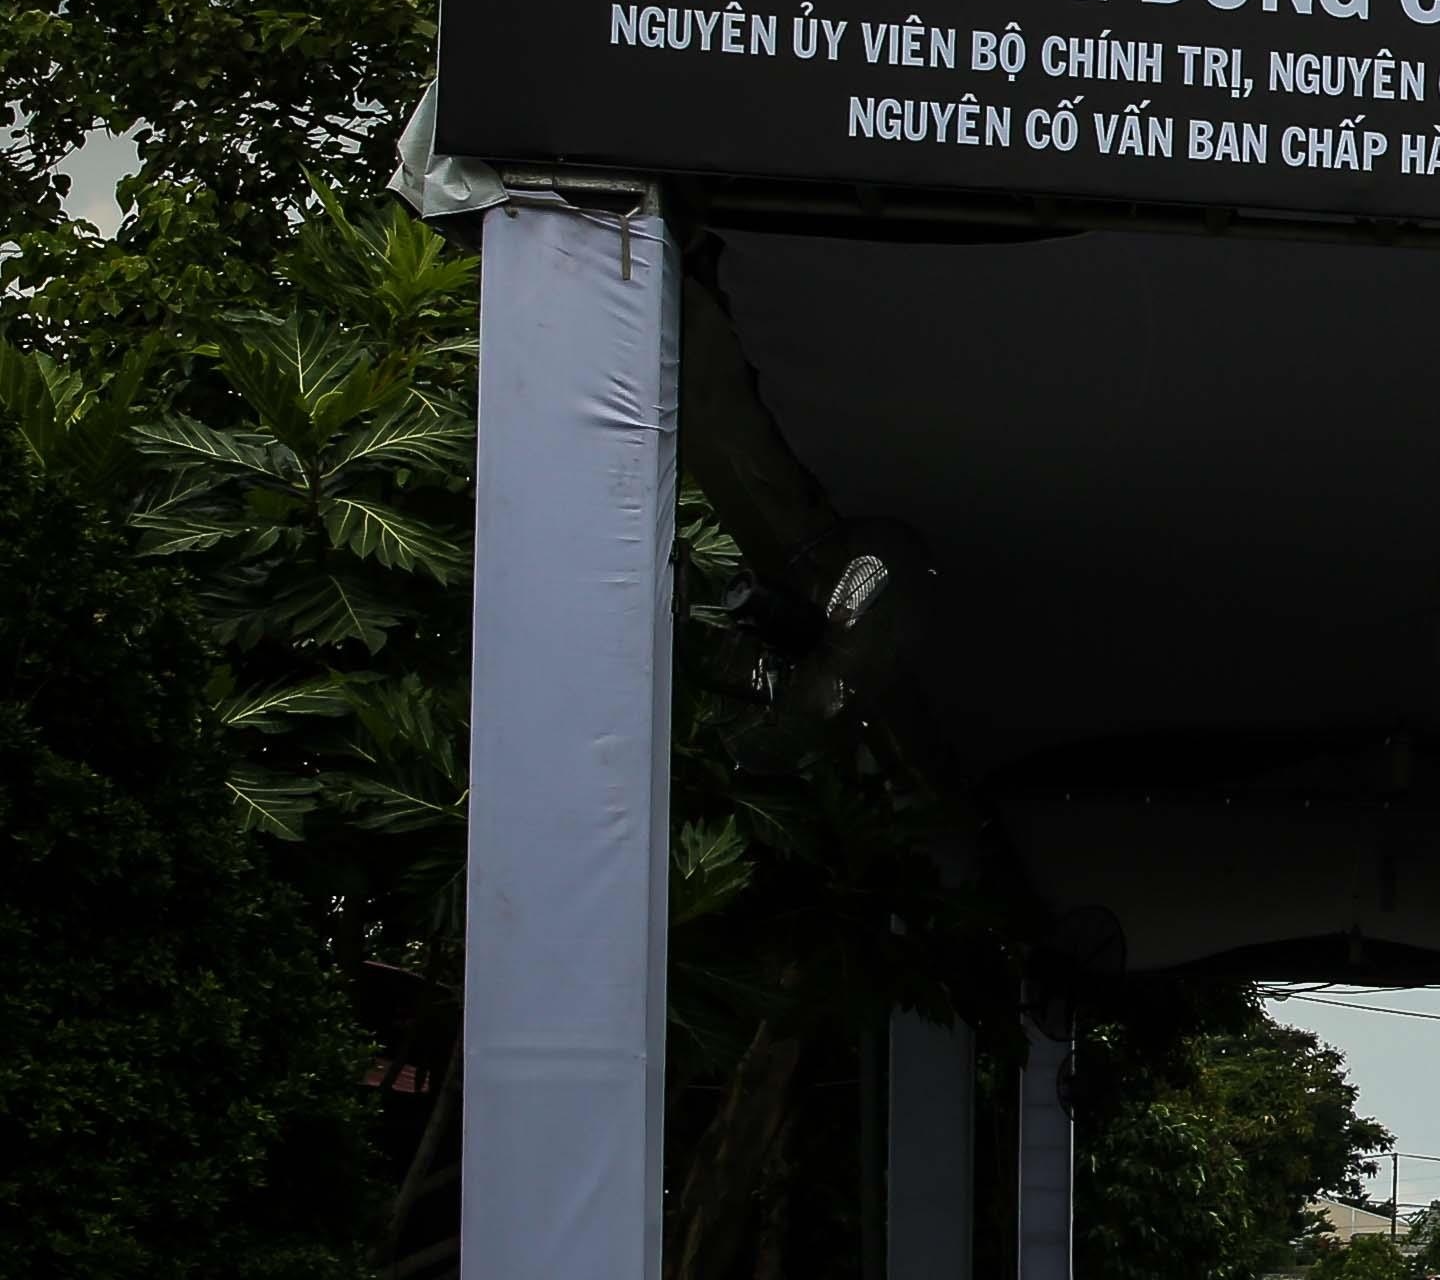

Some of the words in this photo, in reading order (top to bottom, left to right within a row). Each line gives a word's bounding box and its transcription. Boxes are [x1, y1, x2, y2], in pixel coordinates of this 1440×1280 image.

[610, 1, 777, 56] NGUYÊN
[793, 1, 849, 61] ỦY
[860, 14, 956, 69] VIÊN
[971, 21, 1026, 82] BỘ
[1041, 29, 1163, 84] CHÍNH
[1177, 44, 1254, 99] TRỊ,
[1268, 48, 1425, 102] NGUYÊN
[848, 92, 1011, 147] NGUYÊN
[1025, 95, 1085, 152] CỐ
[1092, 99, 1174, 158] VẤN
[1188, 119, 1268, 164] BAN
[1281, 114, 1388, 172] CHẤP
